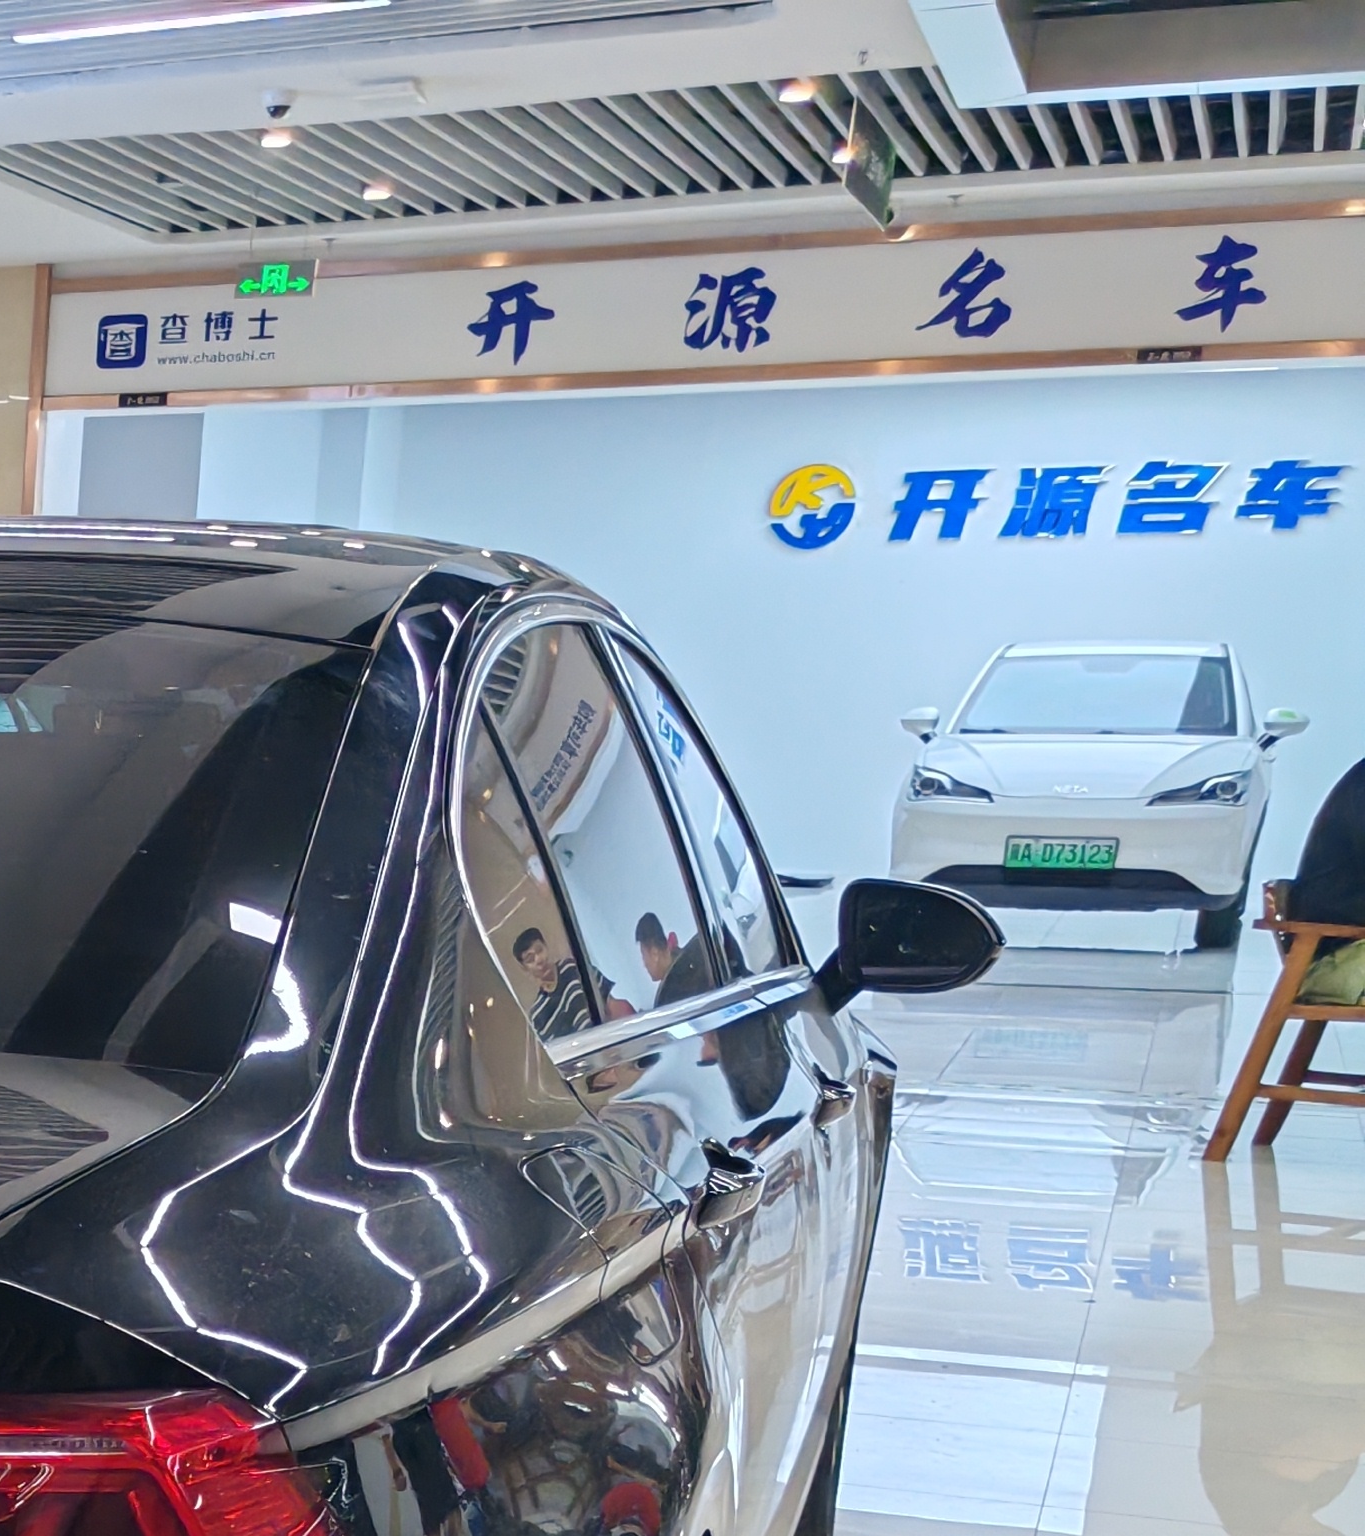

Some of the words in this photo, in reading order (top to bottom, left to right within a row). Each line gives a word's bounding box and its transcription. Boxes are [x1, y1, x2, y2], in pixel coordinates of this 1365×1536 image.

[158, 308, 279, 345] 查博士
[467, 235, 1267, 366] 开源名车
[886, 459, 1353, 544] 开源名车
[1009, 843, 1114, 865] A·D73123
